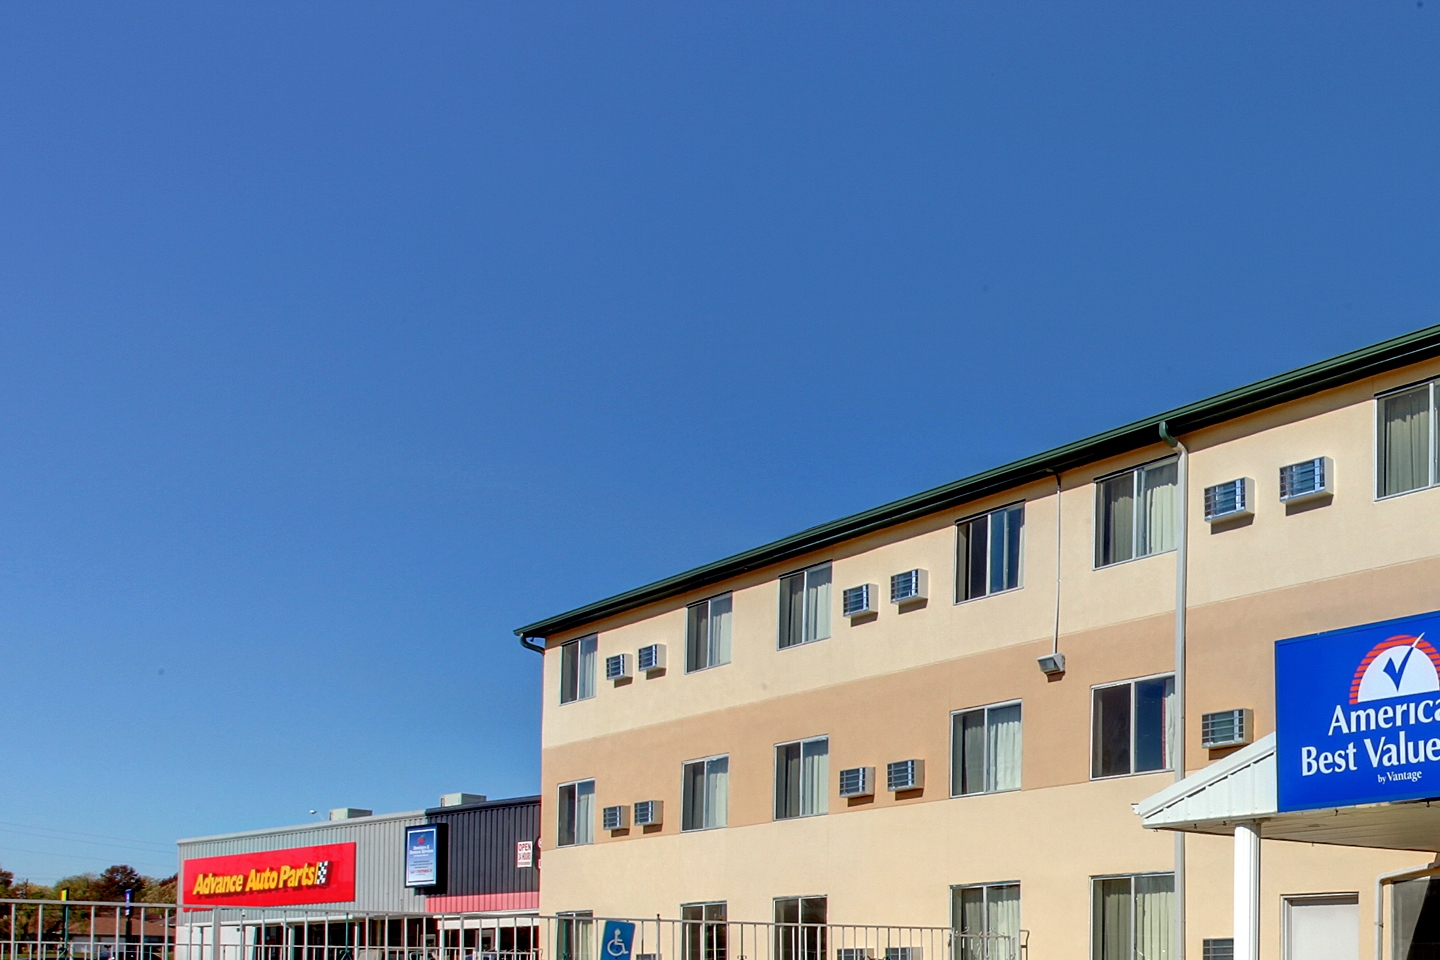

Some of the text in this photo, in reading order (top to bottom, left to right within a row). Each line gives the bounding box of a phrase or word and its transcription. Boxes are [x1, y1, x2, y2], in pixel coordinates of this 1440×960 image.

[1300, 741, 1358, 777] Best
[1377, 770, 1423, 785] by Vantage
[192, 862, 316, 896] Advance Auto Parts
